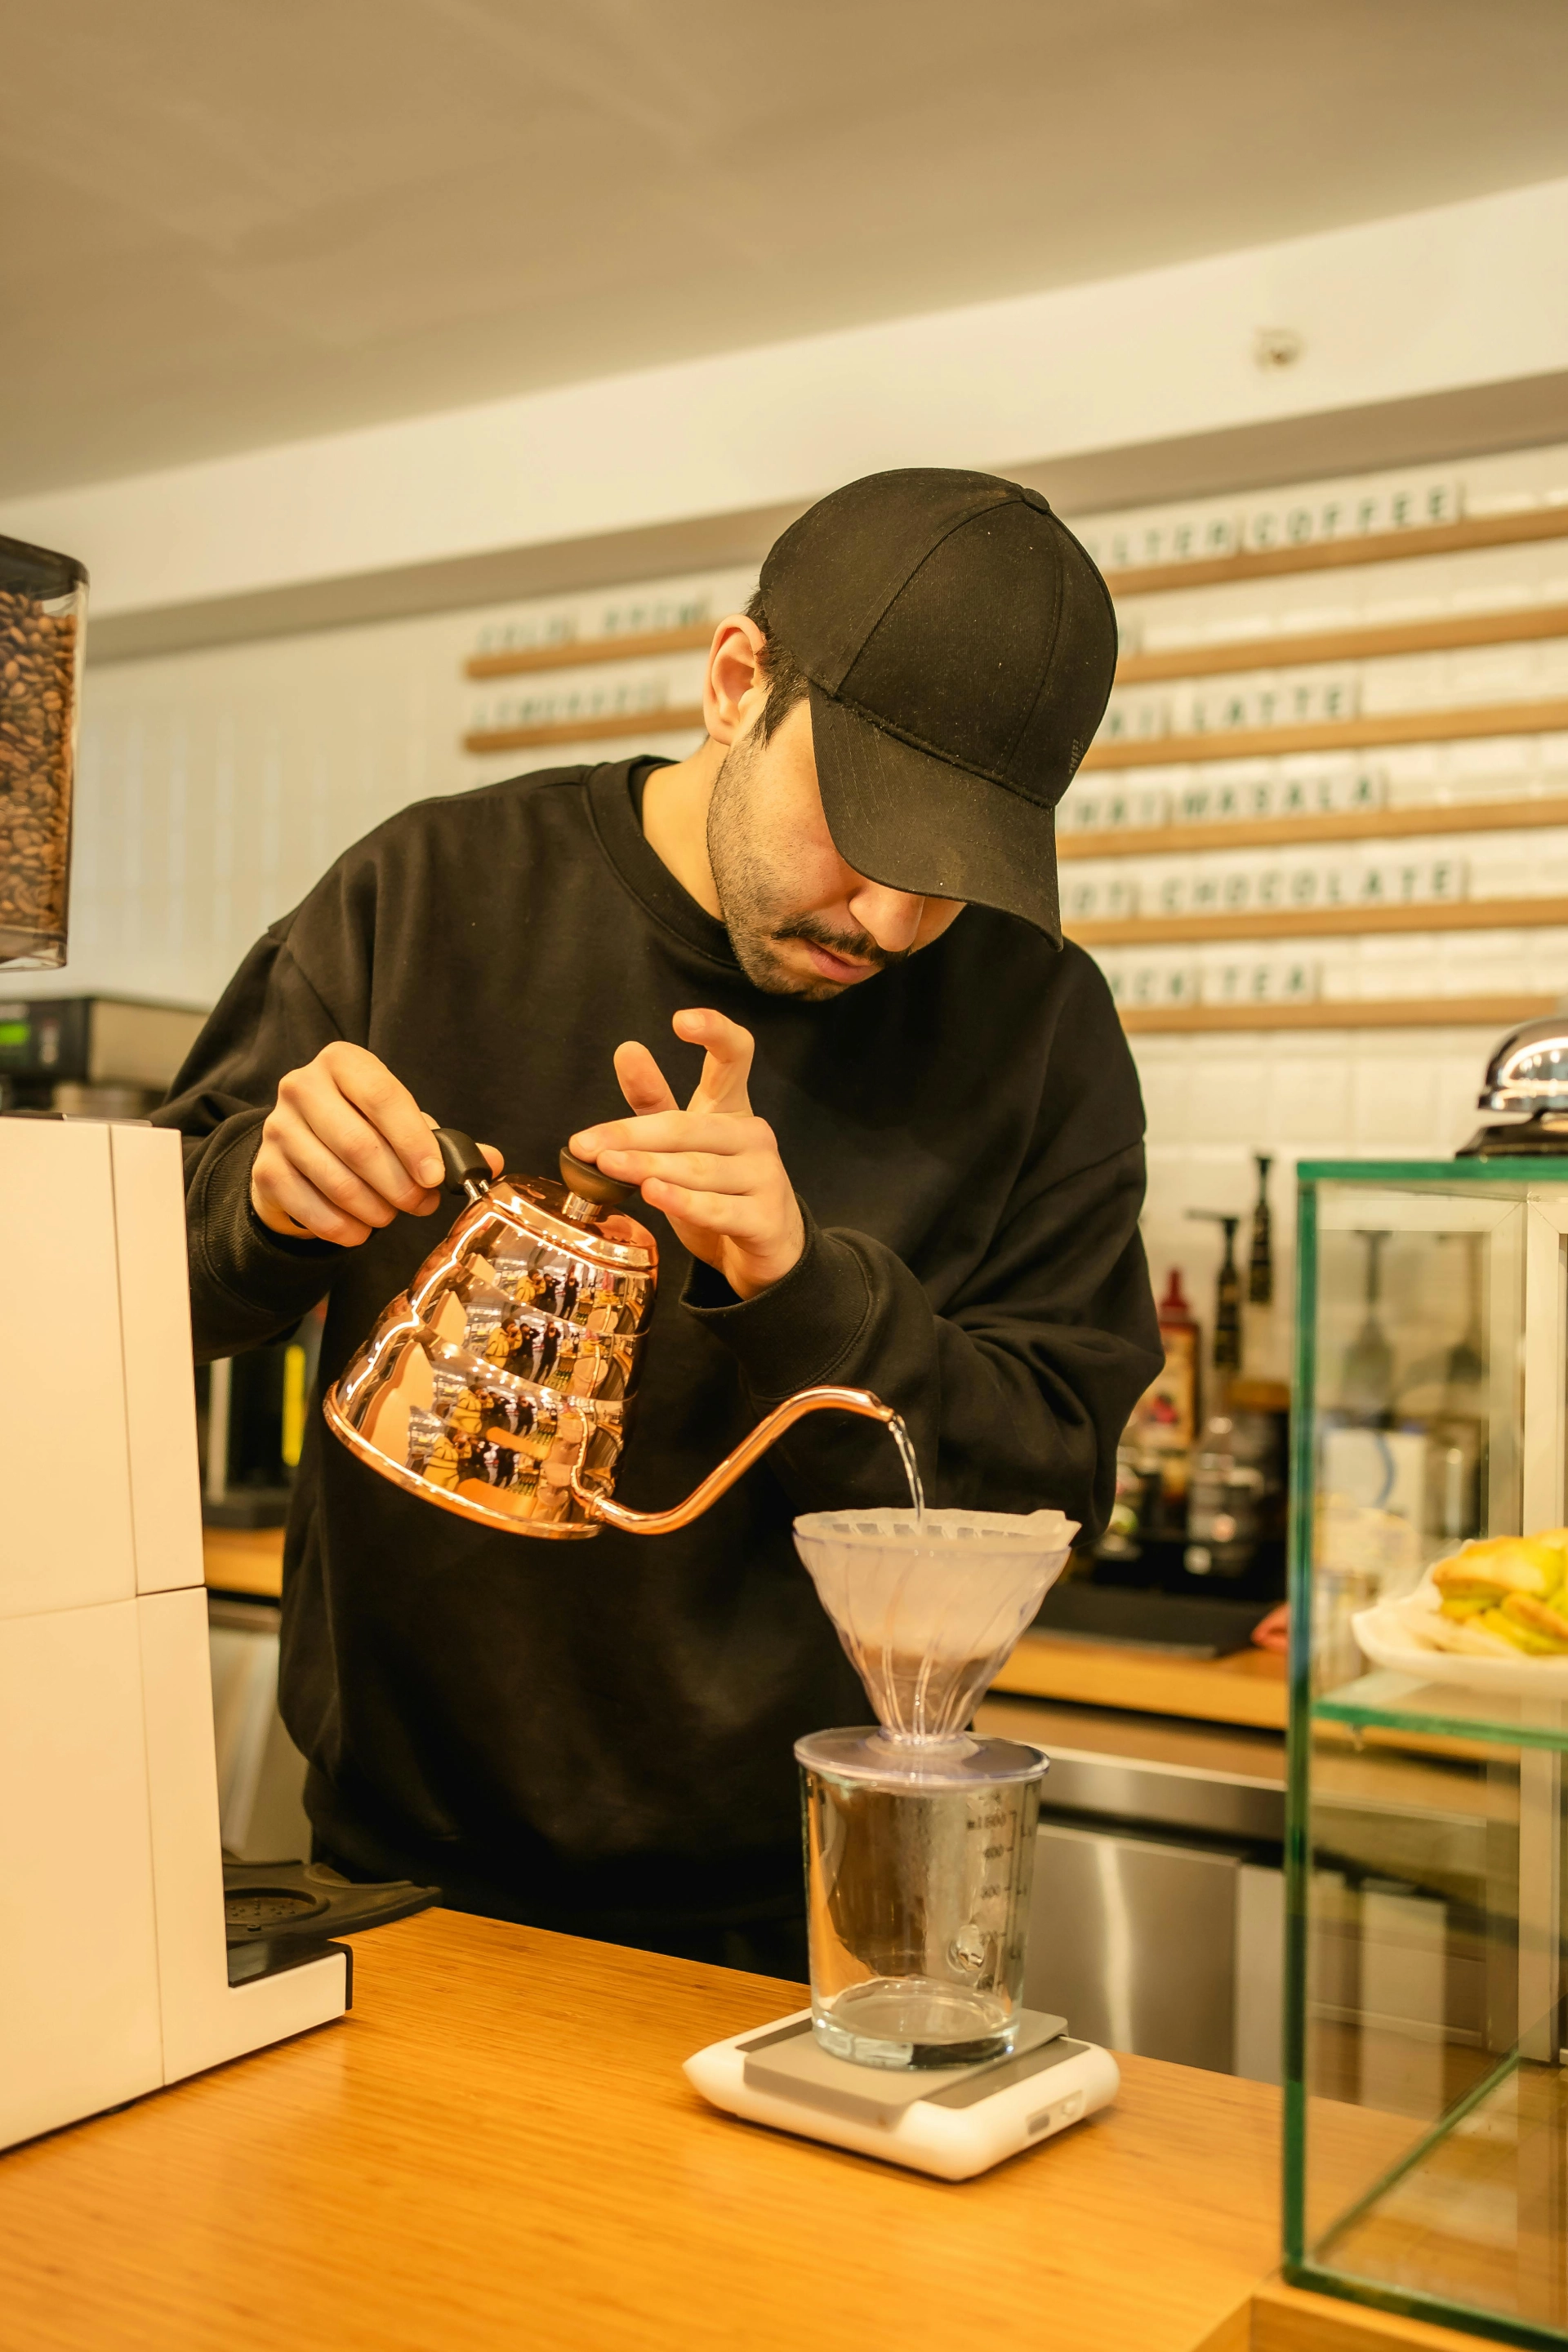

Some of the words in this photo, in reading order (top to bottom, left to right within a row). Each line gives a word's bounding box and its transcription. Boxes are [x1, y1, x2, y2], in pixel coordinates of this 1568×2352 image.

[1253, 488, 1446, 546] COFFEE
[1192, 687, 1343, 730] LATTE
[1160, 862, 1450, 914] CHOCOLATE
[1223, 963, 1307, 998] TEA
